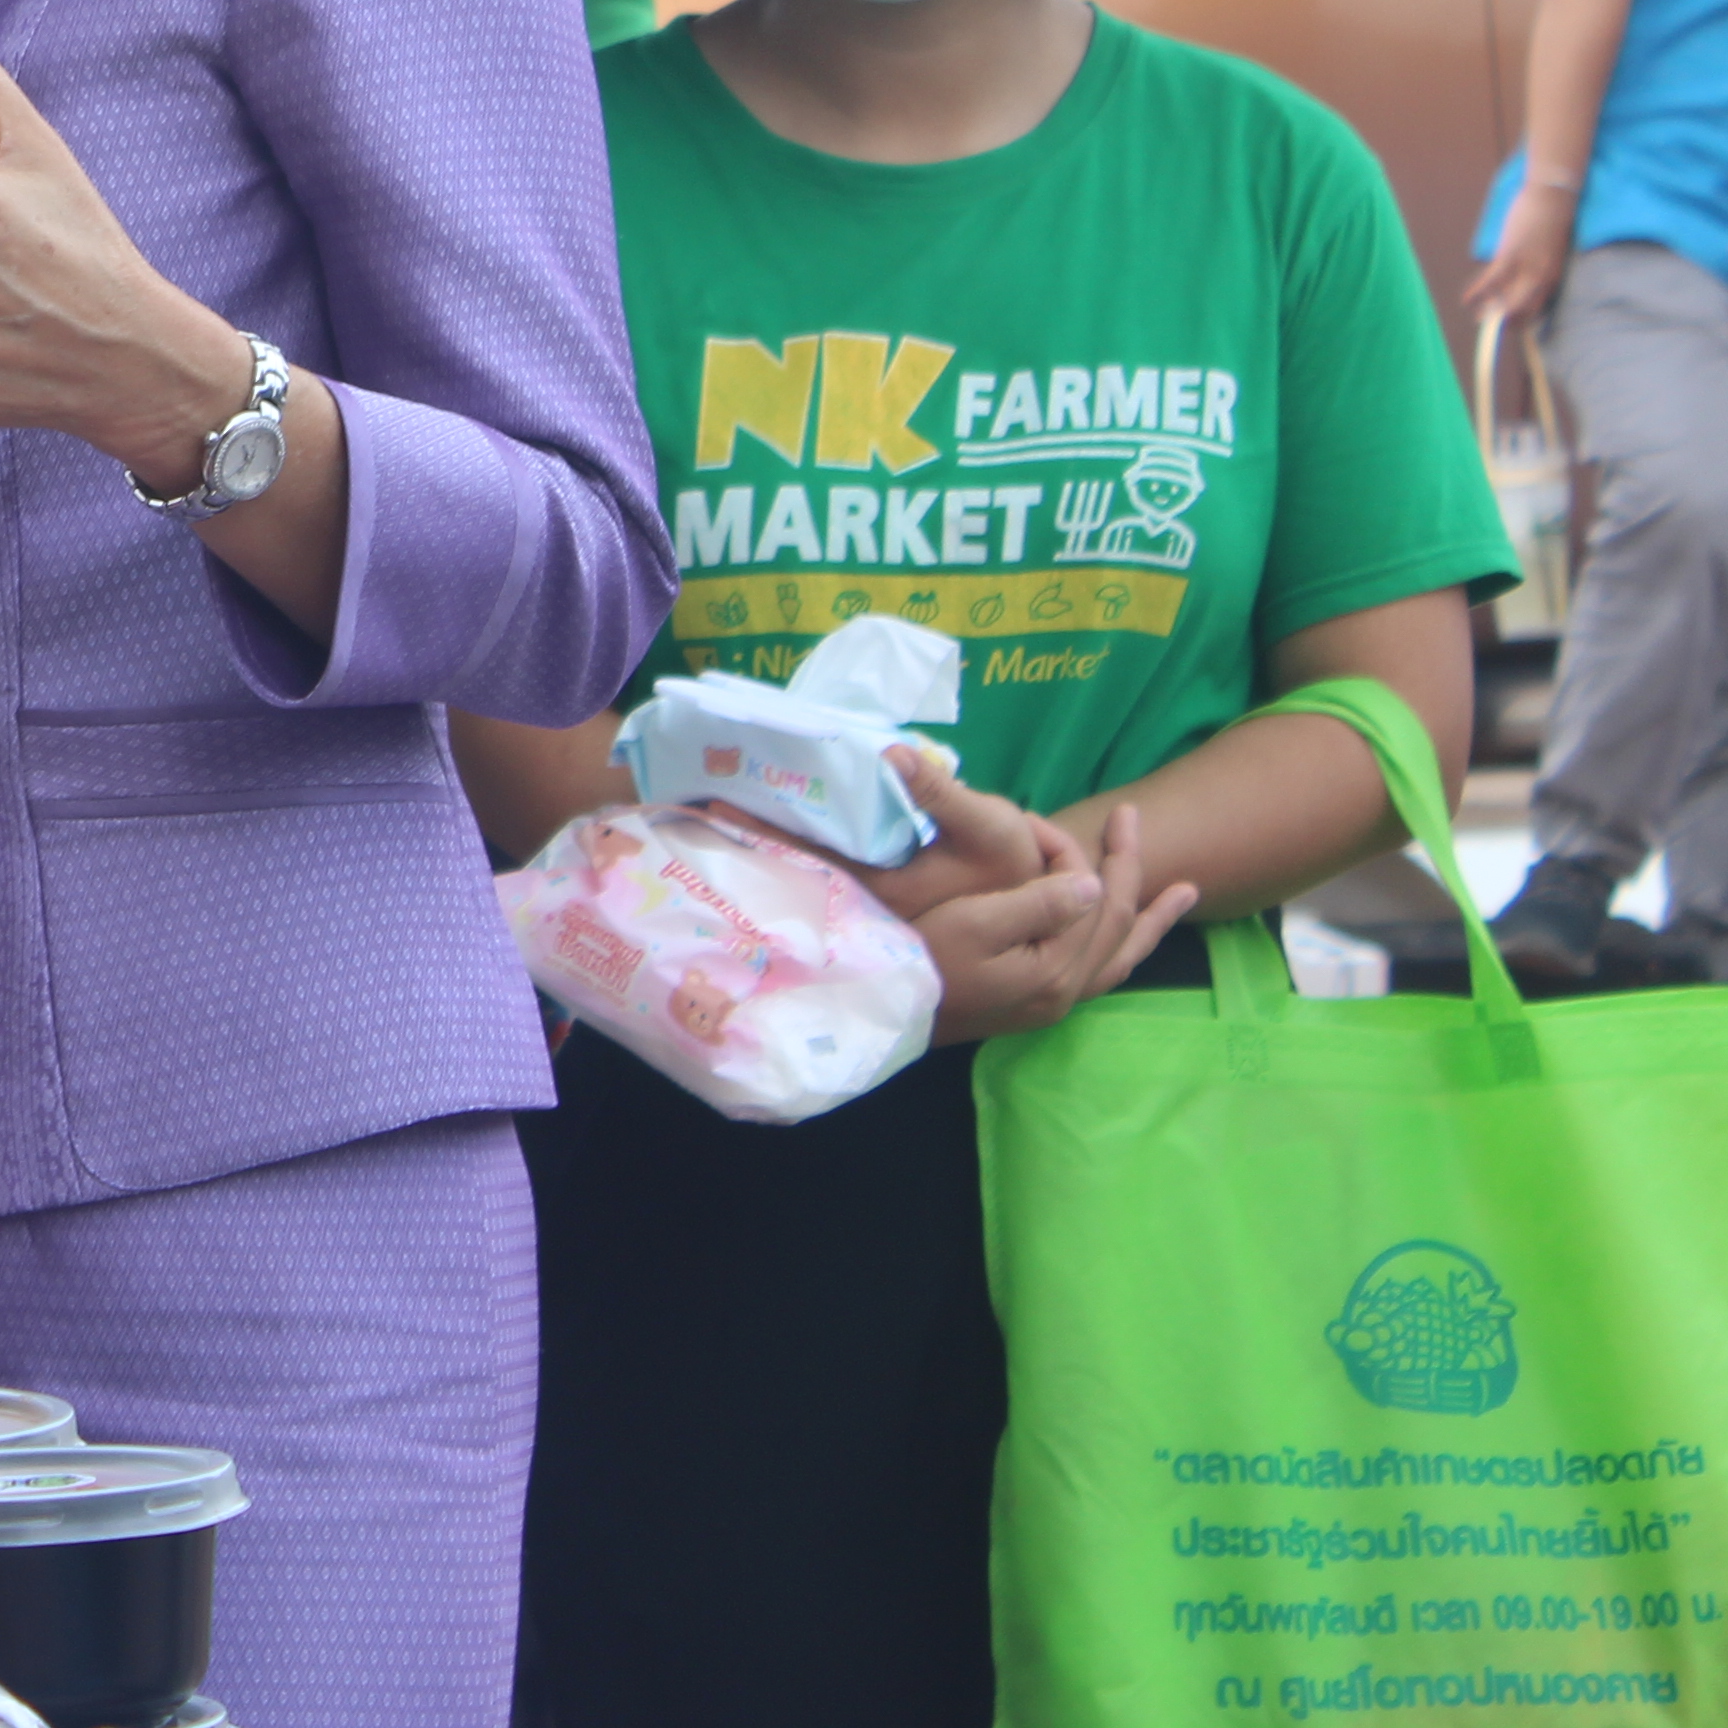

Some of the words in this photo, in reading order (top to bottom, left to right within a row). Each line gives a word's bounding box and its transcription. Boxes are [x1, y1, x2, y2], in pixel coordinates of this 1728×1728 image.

[695, 330, 956, 475] NK
[954, 364, 1239, 442] FARMER
[673, 483, 1043, 568] MARKET
[982, 642, 1112, 687] Market
[1411, 1598, 1480, 1633] เวลา
[1216, 1676, 1262, 1709] ณ
